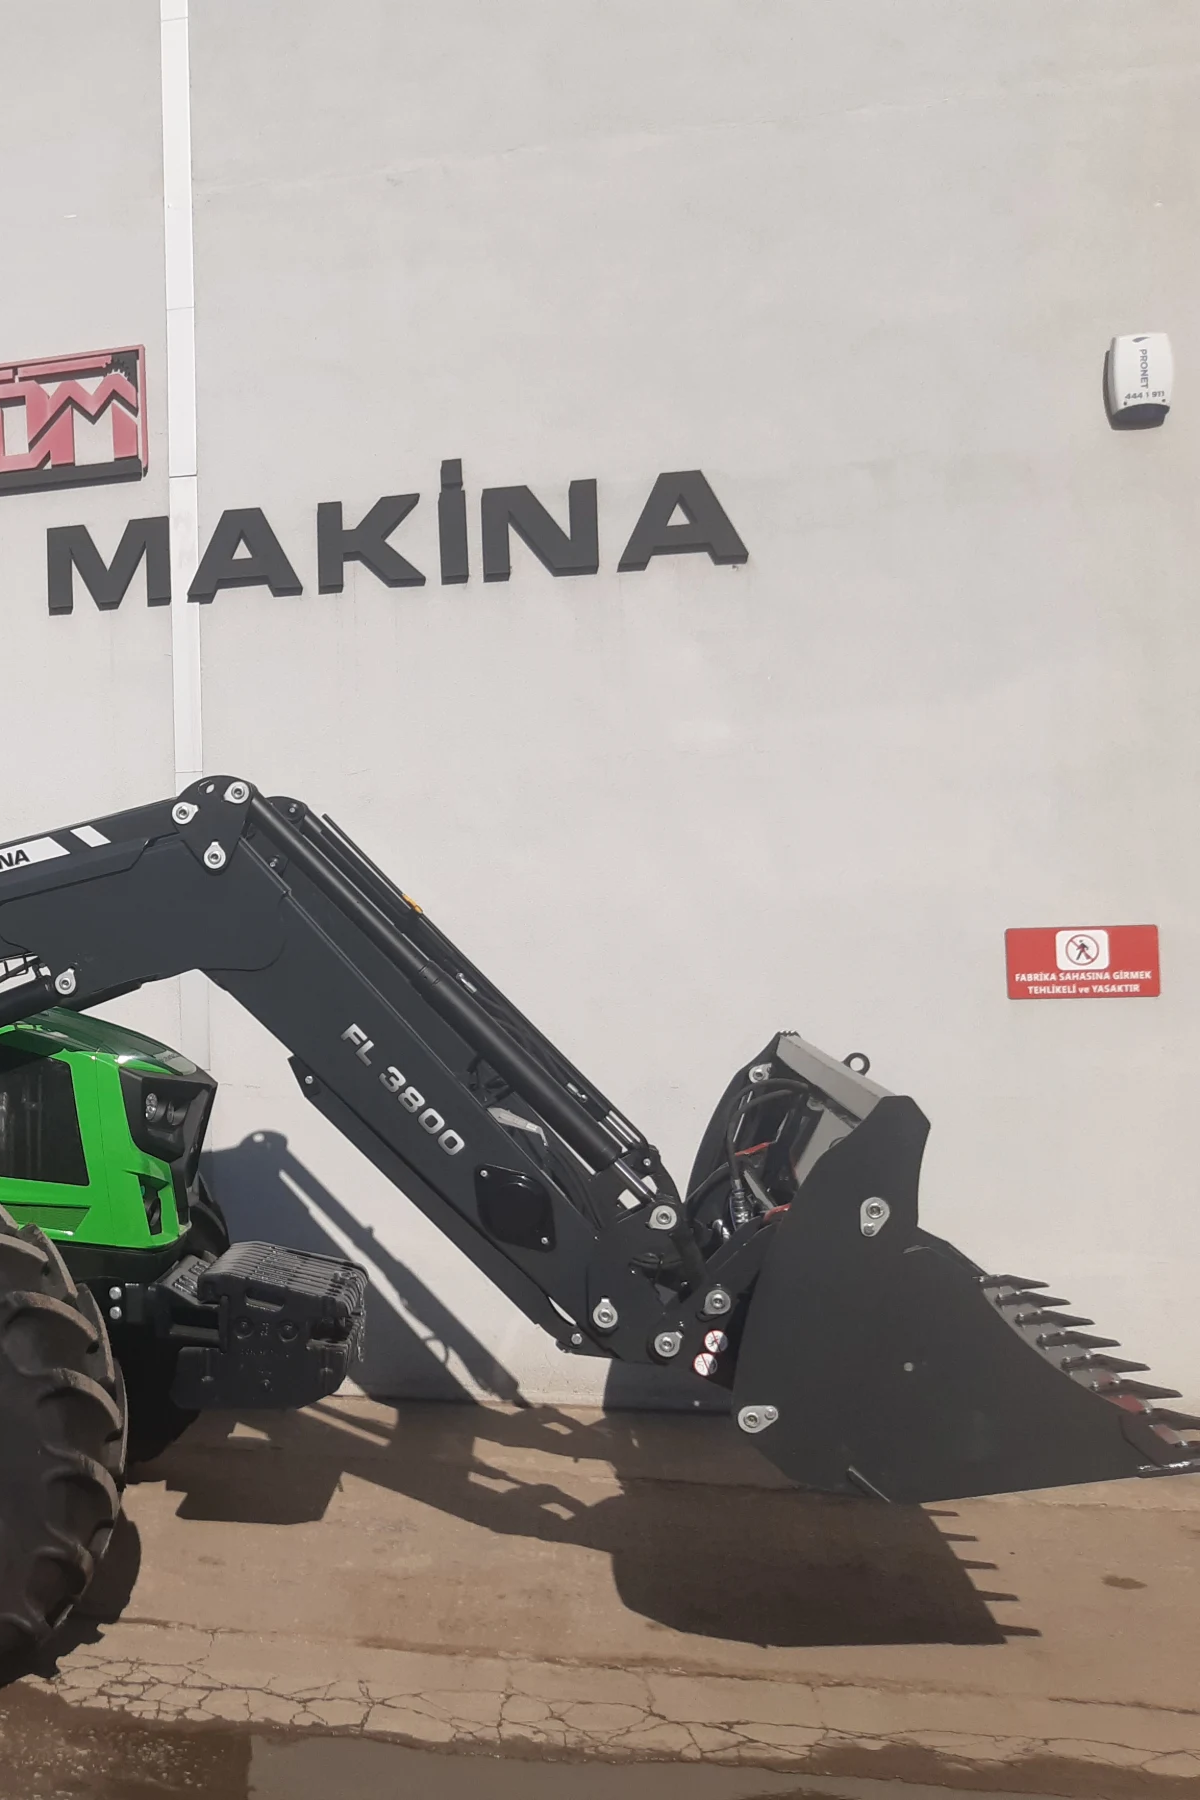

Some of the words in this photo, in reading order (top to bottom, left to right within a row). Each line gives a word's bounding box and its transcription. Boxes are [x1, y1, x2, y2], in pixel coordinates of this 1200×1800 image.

[1140, 349, 1148, 388] PRONET
[46, 457, 749, 616] MAKİNA
[1015, 973, 1056, 981] FABRİKA
[1059, 972, 1110, 980] SAHASINA
[1113, 971, 1151, 979] GİRMEK
[1028, 985, 1076, 994] TEHLİKELİ
[1078, 986, 1090, 994] ve
[1093, 984, 1140, 993] YASAKTIR
[340, 1023, 375, 1067] FL
[378, 1065, 465, 1156] 3800
